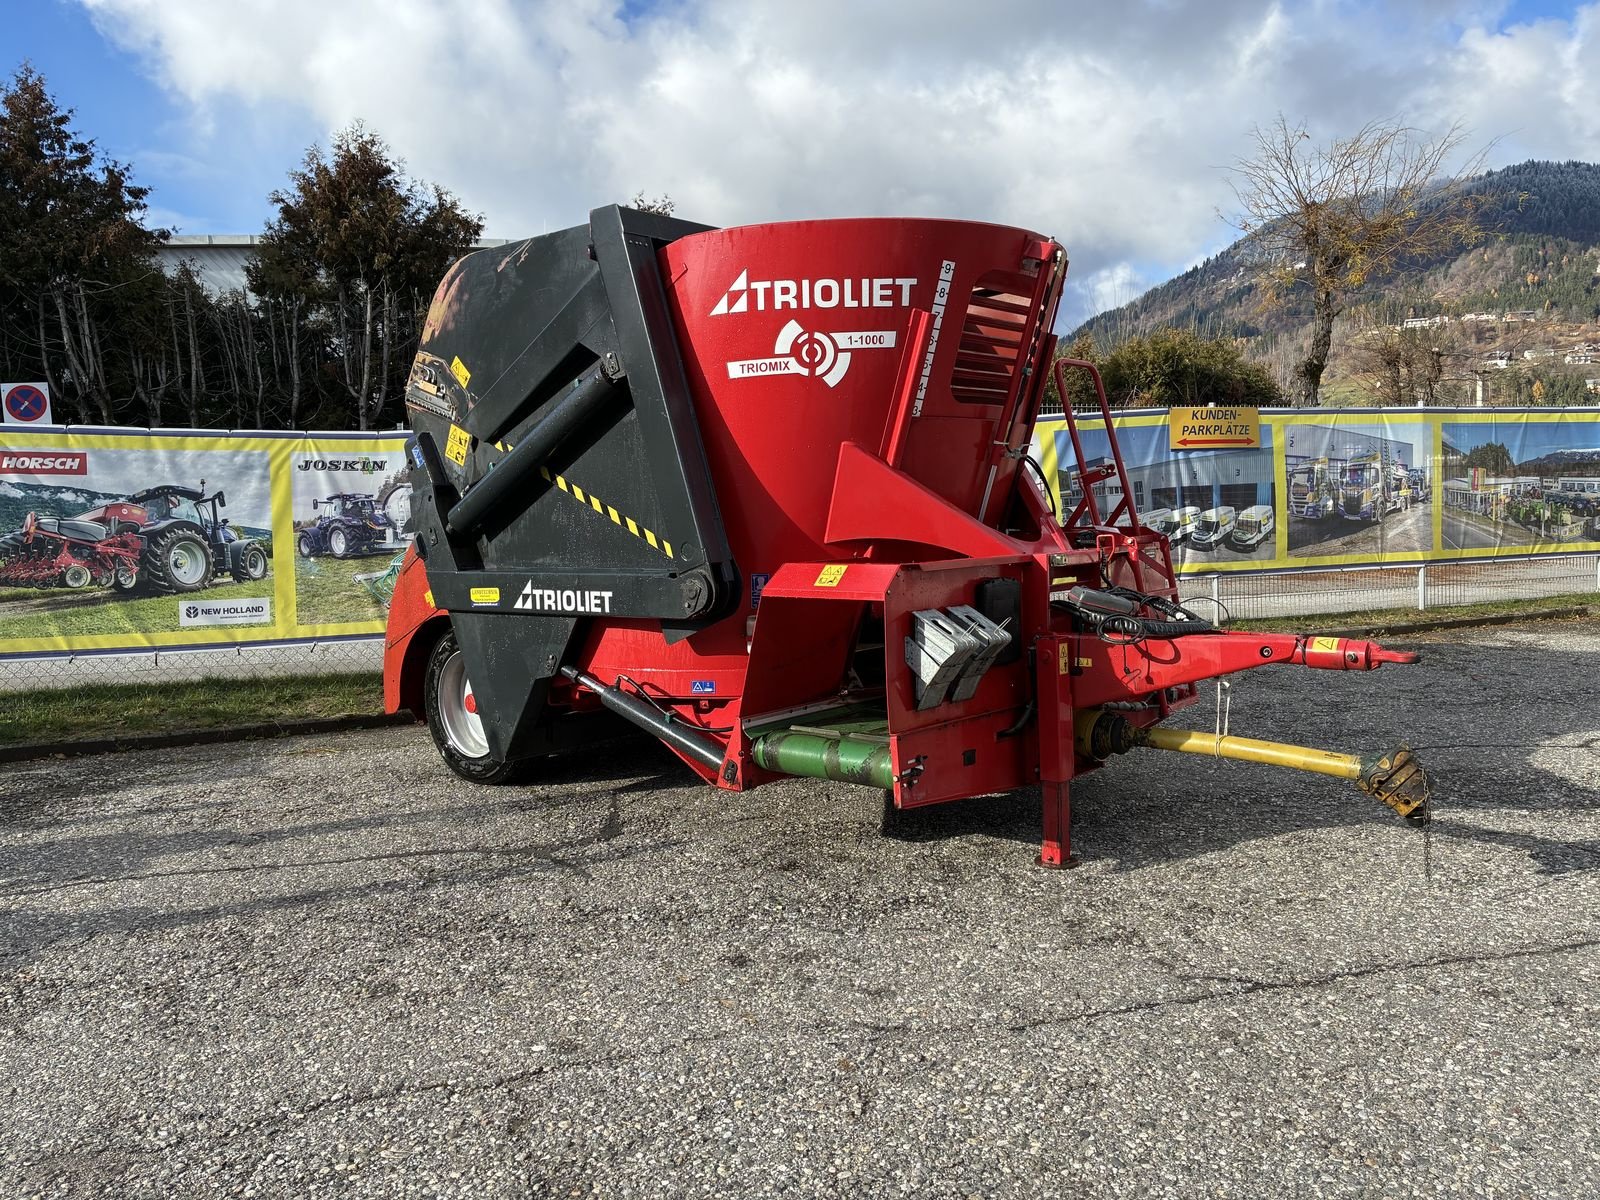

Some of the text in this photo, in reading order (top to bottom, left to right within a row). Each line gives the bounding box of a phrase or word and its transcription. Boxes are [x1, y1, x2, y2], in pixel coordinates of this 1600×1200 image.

[944, 263, 952, 274] 9
[750, 278, 918, 311] TRIOLIET
[938, 287, 946, 298] 8
[847, 334, 885, 345] 1-1000
[739, 360, 791, 374] TRIOMIX
[1191, 409, 1242, 420] KUNDEN-
[1181, 421, 1250, 436] PARKPLÄTZE
[2, 456, 80, 470] HORSCH
[297, 459, 387, 472] JOSKIN
[532, 588, 613, 613] TRIOLIET
[223, 605, 264, 615] HOLLAND
